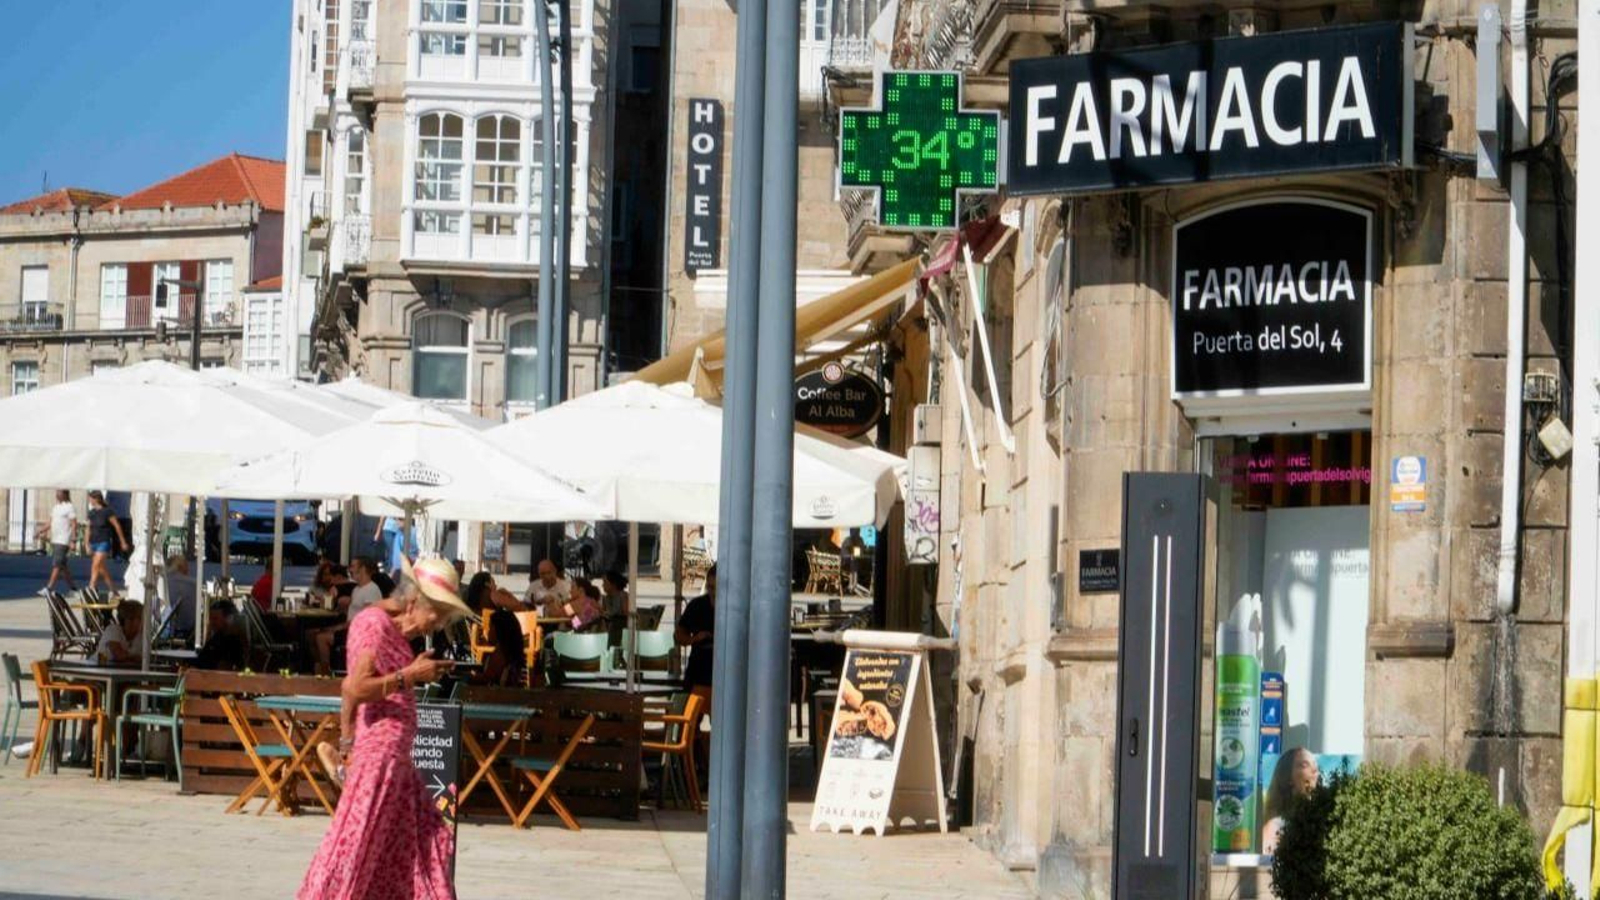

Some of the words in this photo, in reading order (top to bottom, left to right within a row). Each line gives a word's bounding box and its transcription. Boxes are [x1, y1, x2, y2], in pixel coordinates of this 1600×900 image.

[1025, 56, 1376, 167] FARMACIA
[691, 102, 714, 248] HOTEL
[1183, 260, 1356, 311] FARMACIA
[1193, 331, 1253, 355] Puerta
[1258, 324, 1286, 351] del
[1290, 322, 1325, 354] Sol,
[1330, 329, 1343, 353] 4
[797, 386, 841, 401] Coffee
[845, 389, 867, 401] Bar
[826, 405, 856, 418] Alba
[1081, 566, 1117, 577] FARMACIA
[820, 805, 845, 818] TAKE
[852, 809, 882, 821] AWAY
